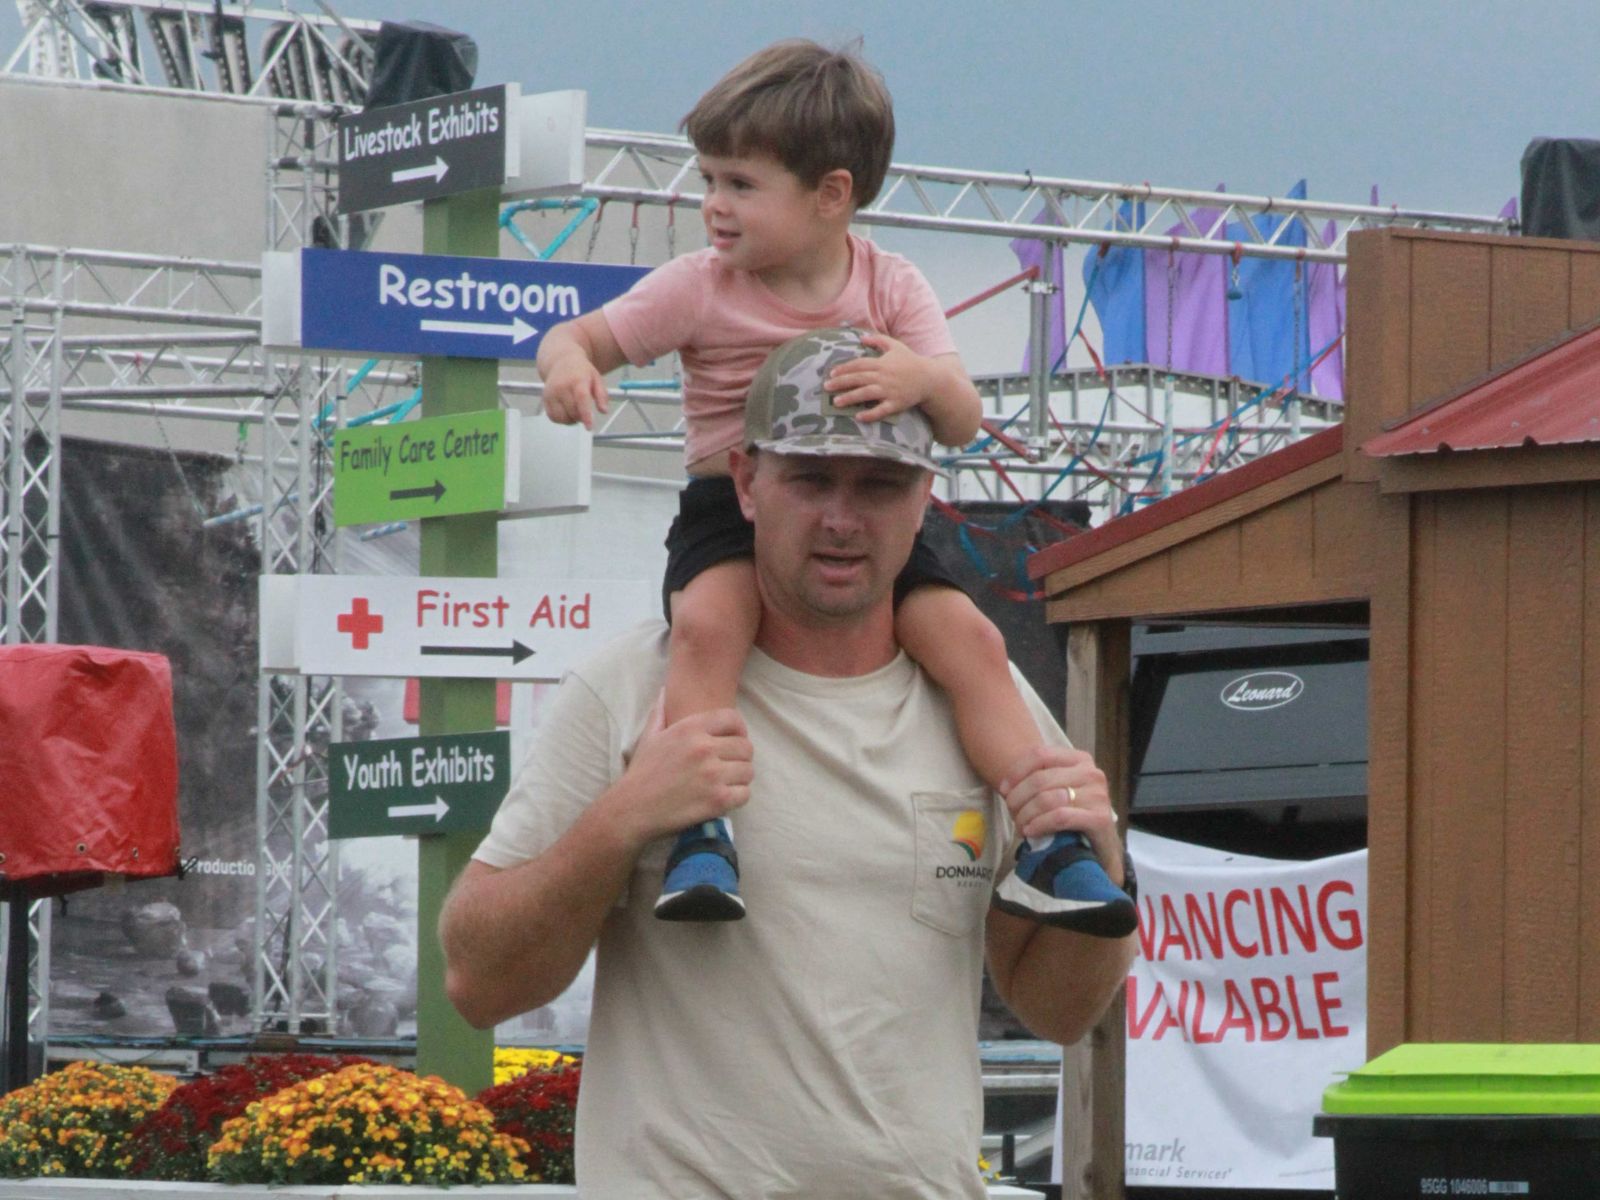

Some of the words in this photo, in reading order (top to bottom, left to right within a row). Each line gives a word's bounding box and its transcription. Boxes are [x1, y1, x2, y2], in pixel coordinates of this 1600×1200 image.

[344, 113, 422, 161] Livestock
[428, 102, 499, 145] Exhibits
[379, 264, 581, 316] Restroom
[339, 436, 392, 476] Family
[398, 434, 436, 464] Care
[443, 429, 499, 459] Center
[417, 590, 510, 628] First
[529, 593, 591, 629] Aid
[1228, 680, 1298, 702] Leonard
[343, 750, 403, 791] Youth
[411, 745, 495, 787] Exhibits
[1137, 880, 1364, 962] NANCING
[1126, 971, 1349, 1044] VAILABLE
